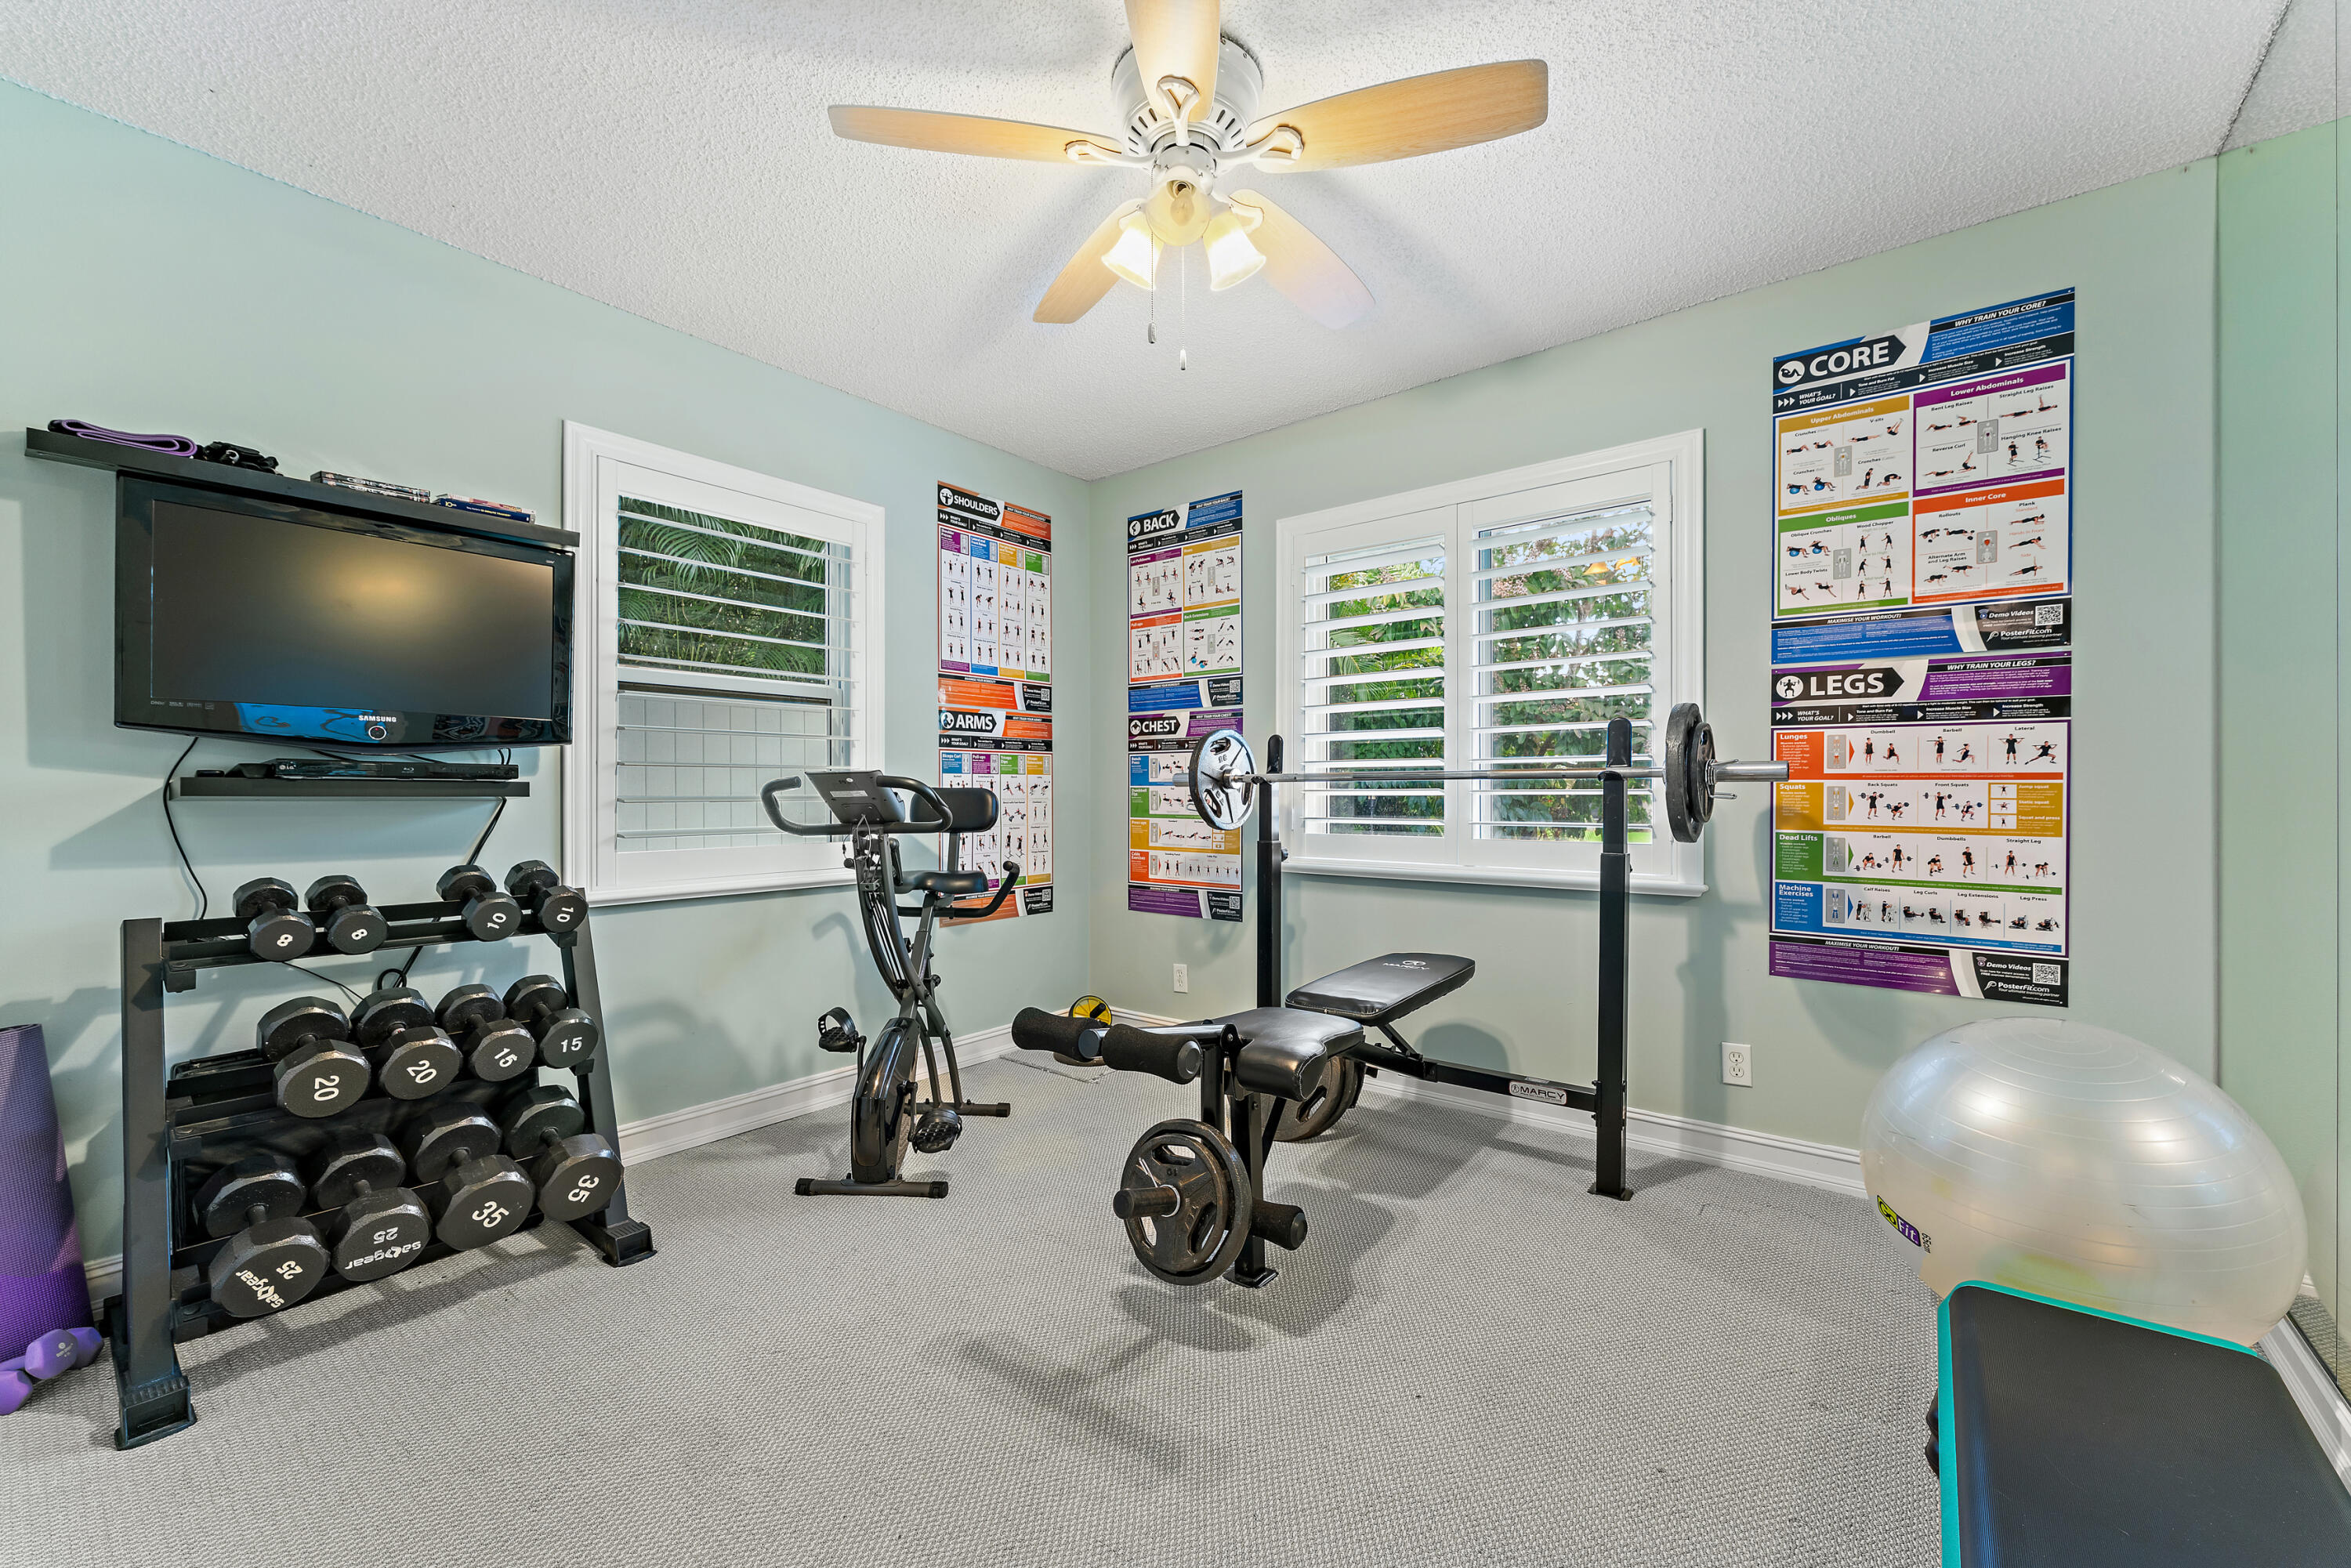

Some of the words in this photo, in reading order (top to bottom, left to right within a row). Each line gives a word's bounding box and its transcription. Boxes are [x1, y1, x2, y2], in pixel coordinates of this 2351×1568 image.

[1955, 318, 1971, 327] WHY
[1974, 313, 1997, 323] TRAIN
[1998, 308, 2020, 317] YOUR
[2021, 301, 2046, 311] CORE?
[1809, 341, 1889, 377] CORE
[1951, 388, 1974, 397] Lower
[1976, 378, 2024, 392] Abdominals
[1817, 393, 1835, 402] GOAL?
[1810, 414, 1831, 424] Upper
[1833, 407, 1874, 419] Abdominals
[954, 495, 998, 516] SHOULDERS
[1143, 513, 1175, 532] BACK
[1826, 513, 1857, 523] Obliques
[1810, 672, 1885, 696] LEGS
[956, 714, 993, 730] ARMS
[1142, 719, 1176, 733] CHEST
[487, 913, 506, 929] 10
[556, 906, 574, 923] 10
[277, 933, 293, 947] 8
[351, 929, 368, 940] 8
[560, 1037, 584, 1054] 15
[494, 1047, 518, 1068] 15
[406, 1059, 437, 1085] 20
[313, 1074, 339, 1102] 20
[1520, 1086, 1565, 1099] MARCY
[568, 1175, 600, 1204] 35
[472, 1200, 509, 1228] 35
[373, 1227, 399, 1244] 25
[276, 1260, 302, 1280] 25
